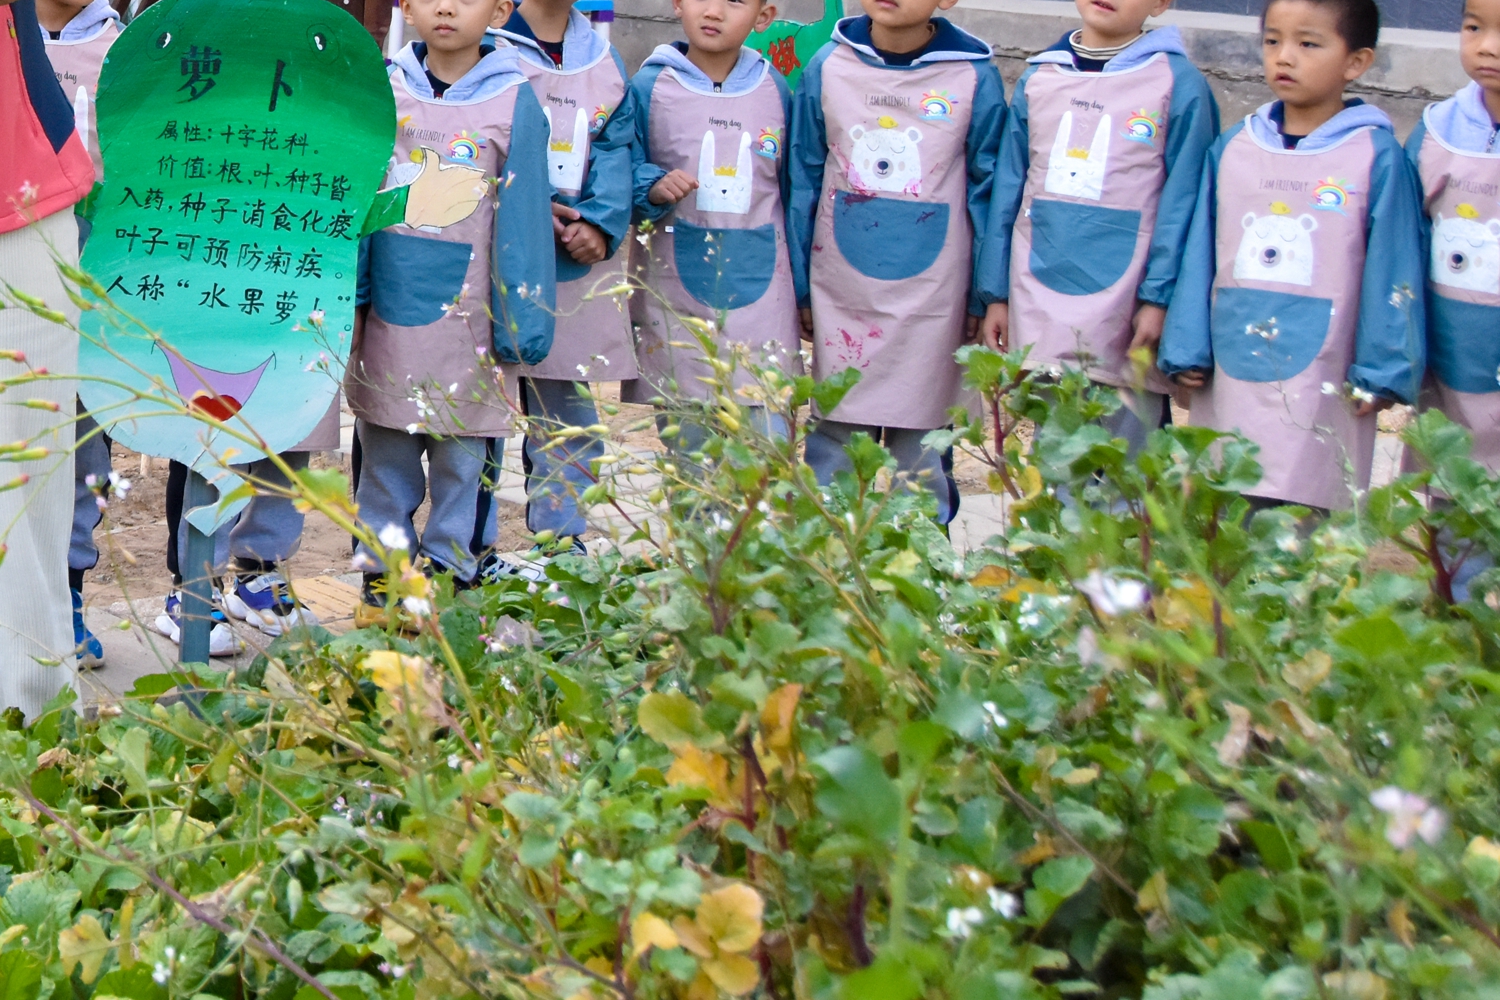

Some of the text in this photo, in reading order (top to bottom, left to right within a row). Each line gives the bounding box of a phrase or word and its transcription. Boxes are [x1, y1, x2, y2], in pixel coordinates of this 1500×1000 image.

[176, 44, 293, 112] 萝卜
[546, 92, 563, 107] Happy
[1070, 97, 1090, 111] Happy
[708, 116, 728, 130] Happy
[405, 127, 415, 138] AM
[415, 128, 446, 143] FRIENDLY
